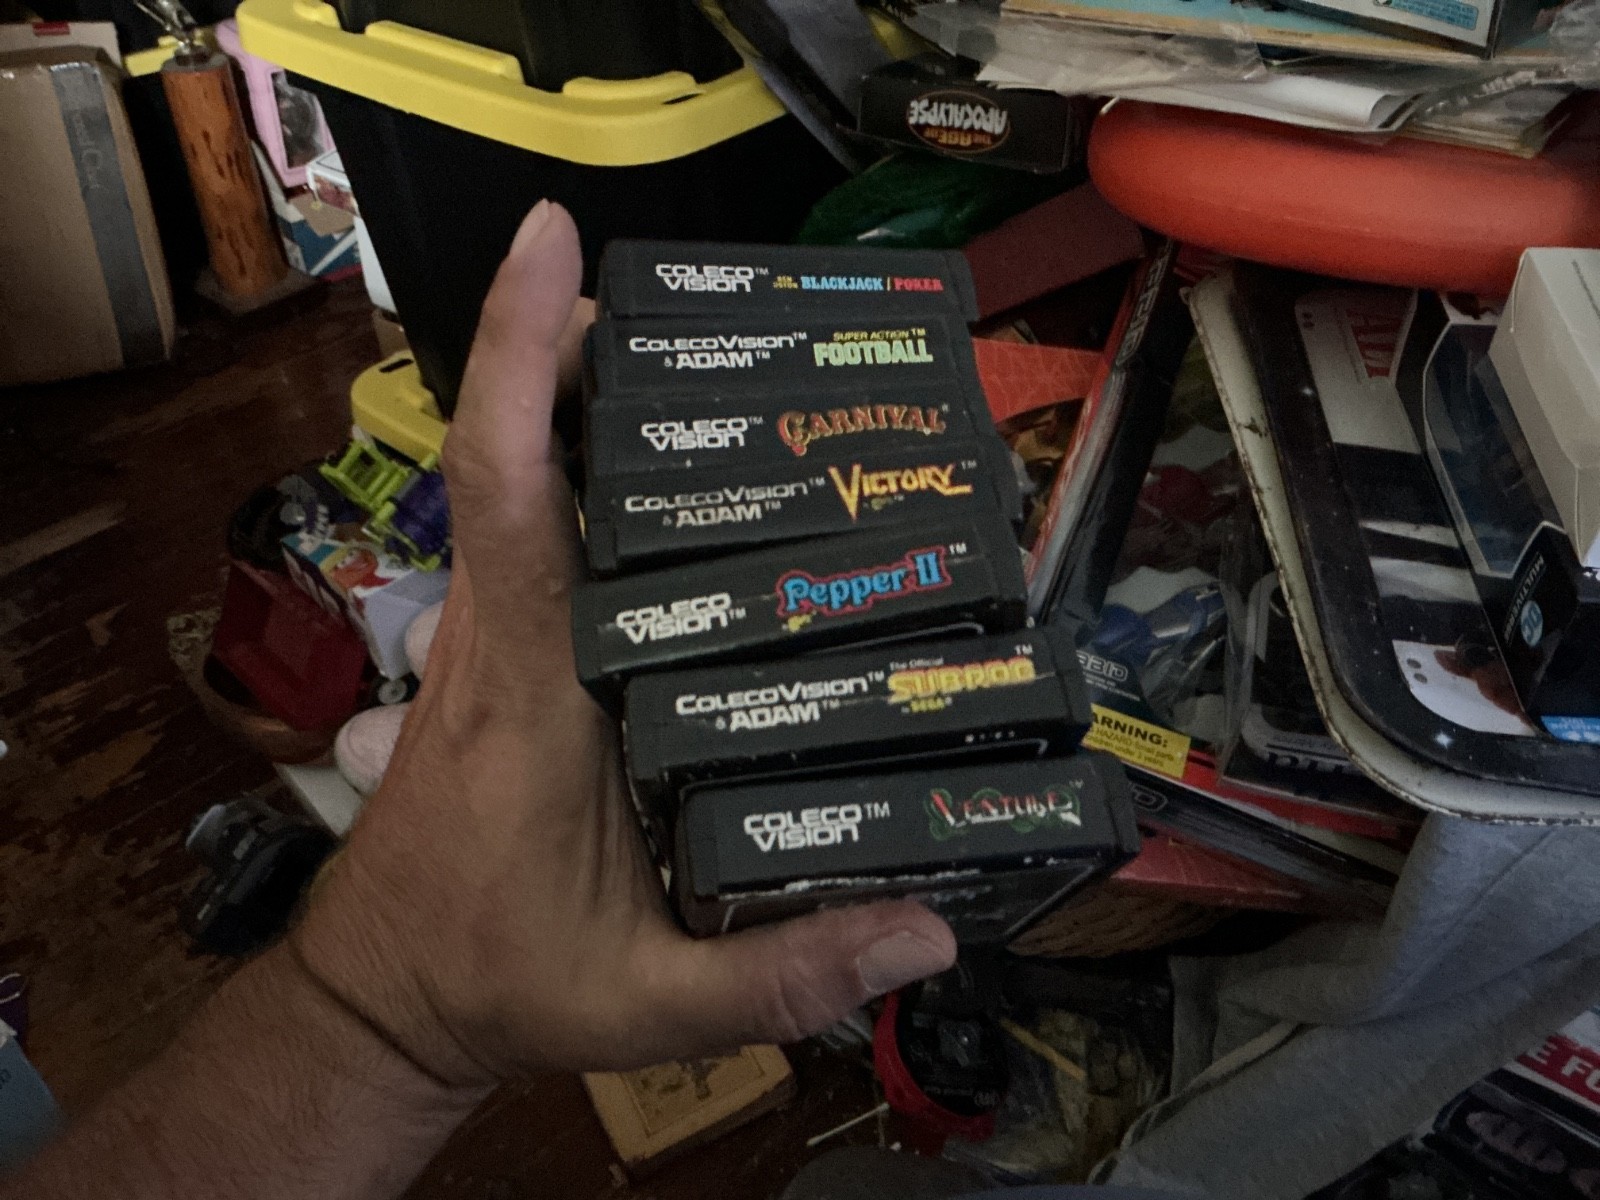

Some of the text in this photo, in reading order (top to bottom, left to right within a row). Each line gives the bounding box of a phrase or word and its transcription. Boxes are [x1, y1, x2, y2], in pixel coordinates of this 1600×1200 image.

[908, 98, 1008, 136] APOCALYPSE
[655, 263, 755, 279] COLECO
[664, 277, 751, 292] VISION
[833, 331, 868, 341] SUPER
[870, 329, 909, 341] ACTION
[676, 353, 753, 369] ADAM
[813, 339, 934, 367] FOOTBALL
[641, 417, 748, 438] COLECO
[650, 431, 744, 451] VISION
[776, 404, 946, 456] CARNIVAL
[828, 463, 973, 523] VICTORY
[675, 505, 762, 528] ADAM
[780, 566, 907, 613] Pepper
[914, 551, 943, 587] II
[616, 593, 731, 629] COLECO
[623, 611, 729, 645] VISION
[729, 701, 820, 733] ADAM
[743, 803, 863, 836] COLECO
[753, 820, 859, 852] VISION
